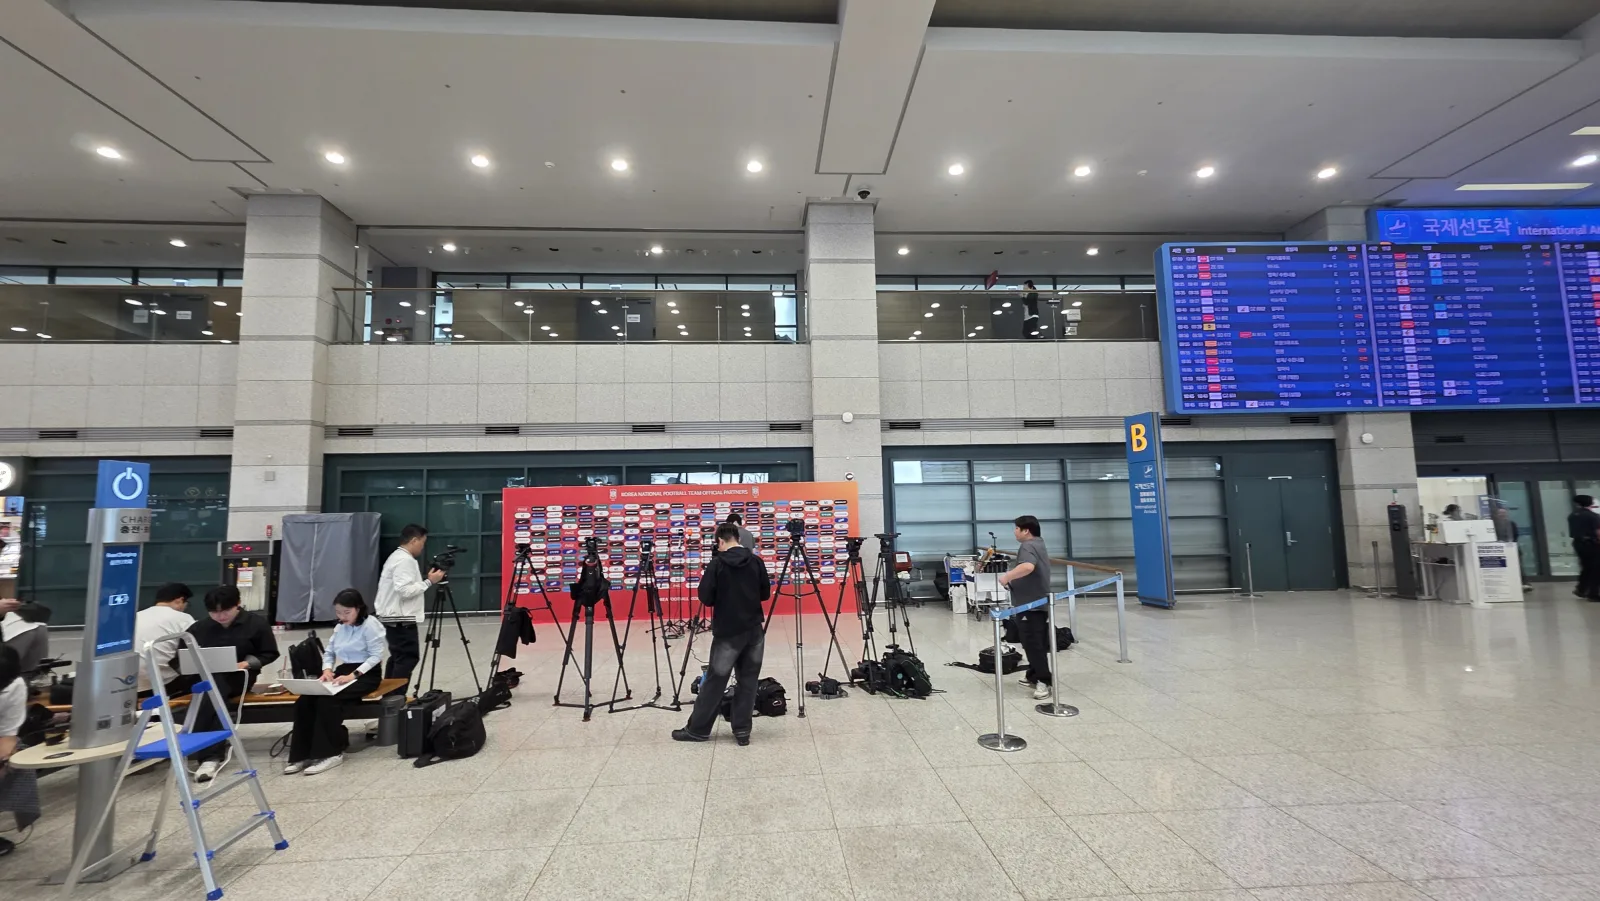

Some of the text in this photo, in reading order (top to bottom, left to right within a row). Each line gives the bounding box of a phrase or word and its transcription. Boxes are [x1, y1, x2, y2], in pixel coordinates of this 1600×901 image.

[1422, 218, 1512, 236] 국제선도착
[1518, 225, 1587, 235] International
[1130, 423, 1148, 452] B
